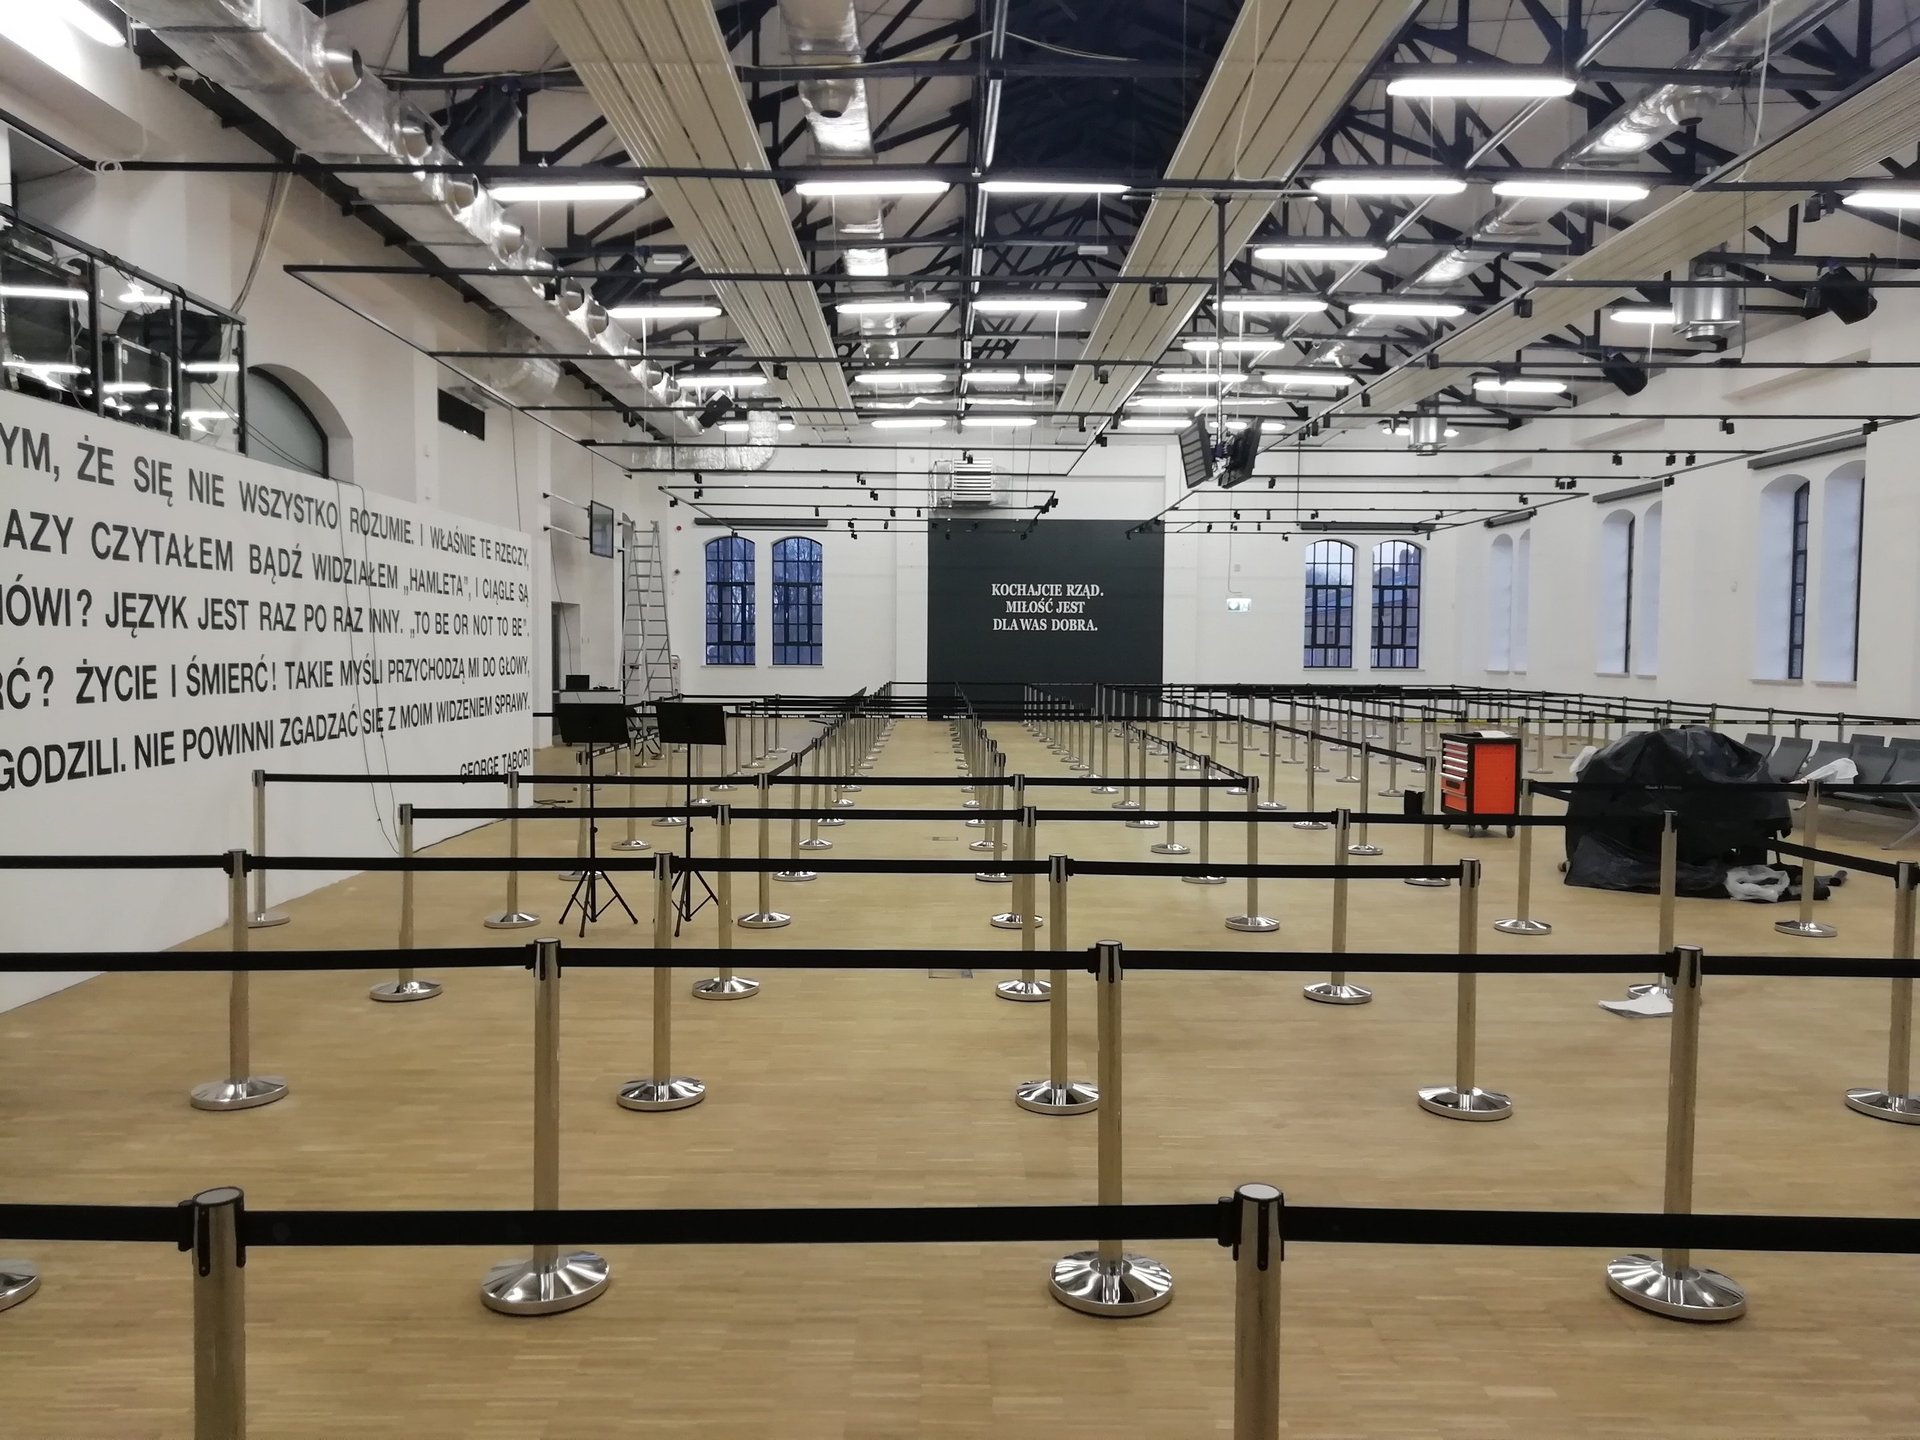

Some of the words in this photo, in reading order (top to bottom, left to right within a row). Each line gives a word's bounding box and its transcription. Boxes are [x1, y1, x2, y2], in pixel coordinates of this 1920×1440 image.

[77, 434, 115, 486] ŻE
[133, 455, 174, 508] SIĘ
[188, 468, 226, 508] NIE
[238, 480, 339, 530] WSZYSTKO
[349, 506, 415, 545] ROZUMIE.
[420, 523, 424, 547] I
[429, 525, 477, 557] WŁAŚNIE
[479, 537, 492, 560] TE
[2, 508, 75, 556] AZY
[91, 521, 234, 573] CZYTAŁEM
[249, 542, 303, 584] BĄDŹ
[312, 552, 399, 590] WIDZIAŁEM
[475, 577, 479, 598] I
[482, 578, 515, 605] CIĄGLE
[518, 583, 529, 608] SĄ
[0, 573, 93, 628] ÓWI?
[105, 591, 189, 638] JĘZYK
[198, 598, 249, 632] JEST
[259, 601, 297, 632] RAZ
[304, 603, 328, 633] PO
[333, 606, 364, 634] RAZ
[369, 607, 404, 634] INNY.
[434, 612, 450, 635] BE
[453, 613, 469, 635] OR
[472, 614, 494, 636] NOT
[497, 616, 509, 636] TO
[991, 583, 1063, 597] KOCHAJCIE
[1066, 583, 1105, 600] RZĄD.
[1006, 597, 1054, 614] MIŁOŚĆ
[1055, 601, 1086, 614] JEST
[992, 618, 1019, 631] DLA
[1019, 618, 1048, 631] WAS
[1051, 618, 1099, 632] DOBRA.
[0, 656, 54, 710] Ć?
[76, 658, 158, 704] ŻYCIE
[171, 663, 178, 698] I
[186, 653, 277, 697] ŚMIERĆ!
[284, 660, 334, 690] TAKIE
[340, 653, 384, 686] MYŚLI
[387, 656, 466, 685] PRZYCHODZĄ
[468, 657, 480, 678] MI
[483, 656, 496, 677] DO
[134, 729, 176, 770] NIE
[183, 719, 275, 762] POWINNI
[280, 703, 359, 748] ZGADZAĆ
[362, 707, 384, 738] SIĘ
[387, 706, 397, 731] Z
[400, 702, 433, 729] MOIM
[436, 696, 493, 723] WIDZENIEM
[494, 692, 531, 715] SPRAWY.
[460, 755, 499, 776] GEORGE
[502, 747, 531, 774] TABORI
